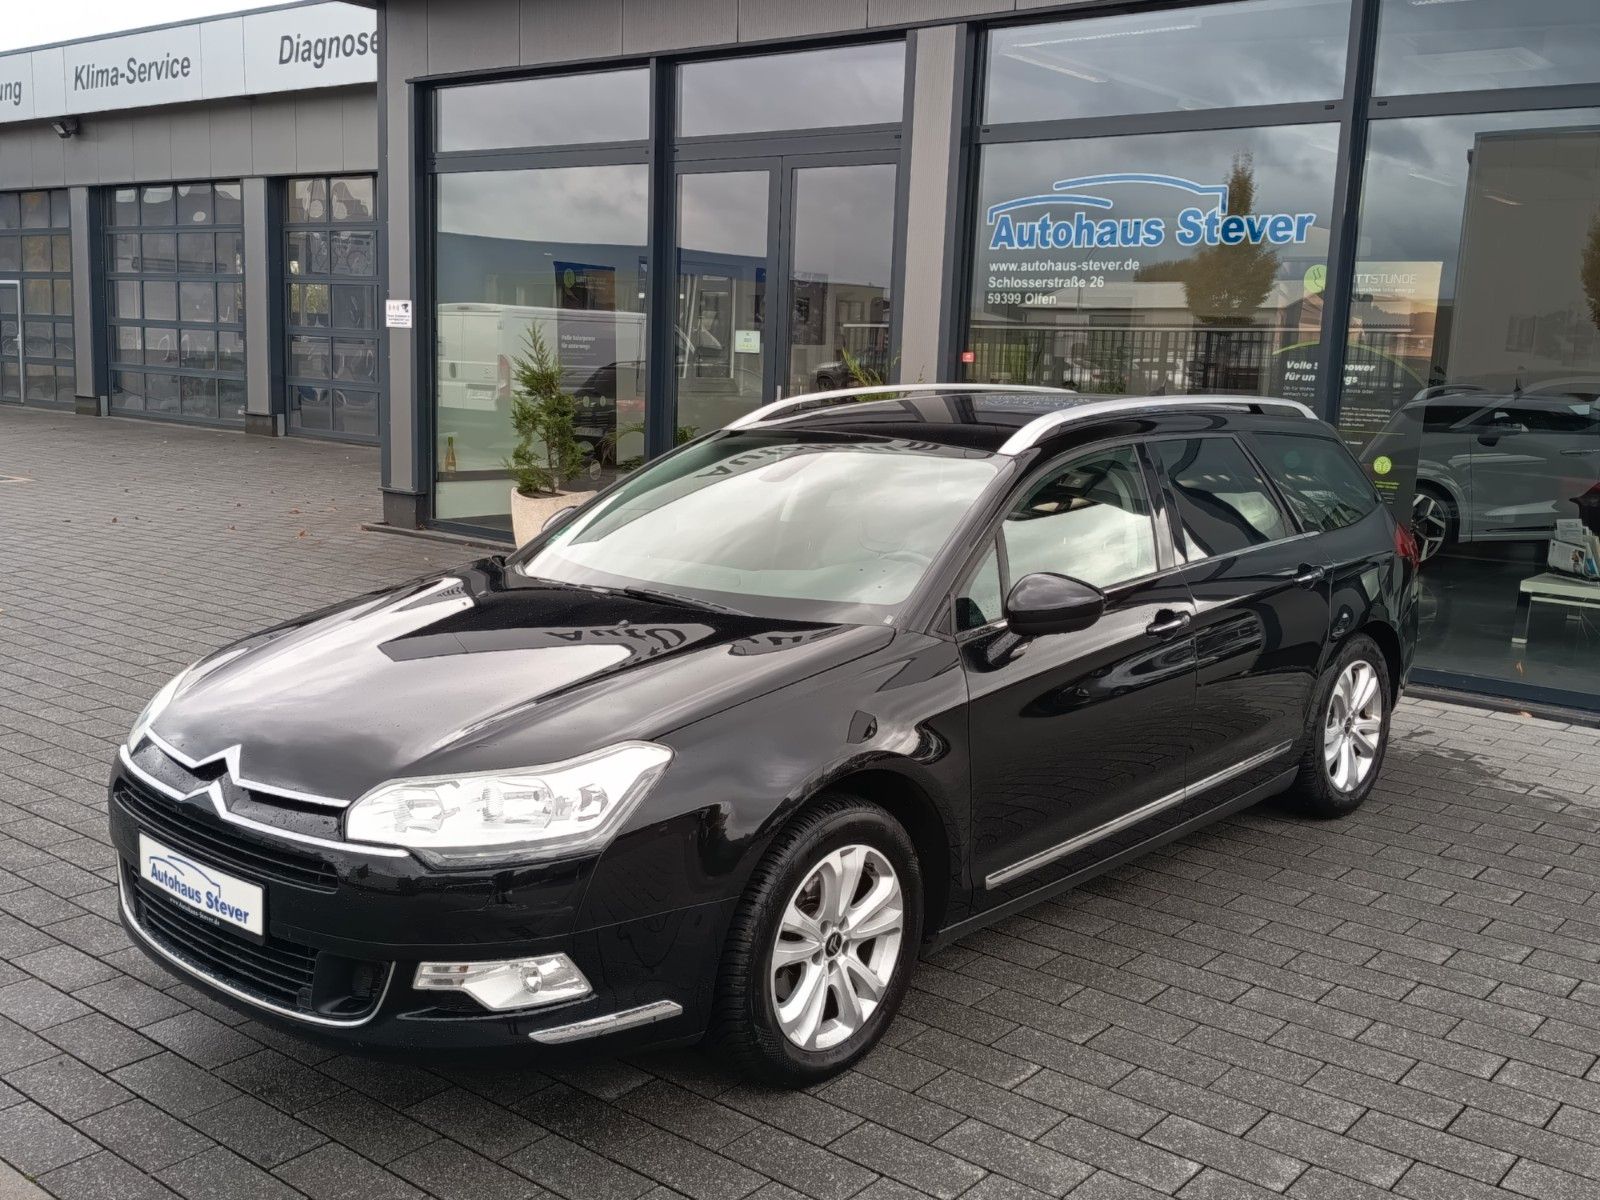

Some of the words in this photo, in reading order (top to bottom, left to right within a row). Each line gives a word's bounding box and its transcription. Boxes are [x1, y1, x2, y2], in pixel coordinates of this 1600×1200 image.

[279, 30, 377, 69] Diagnose
[74, 53, 191, 91] Klima-Service
[989, 211, 1166, 250] Autohaus
[1175, 207, 1316, 246] Stever
[989, 258, 1140, 272] www.autohaus-stever.de
[988, 276, 1086, 288] Schlosserstraße
[1089, 276, 1105, 288] 26
[987, 293, 1021, 305] 59399
[1025, 293, 1057, 305] Olfen
[1286, 361, 1312, 370] Volle
[1284, 372, 1300, 381] für
[151, 863, 202, 903] Autohaus
[205, 891, 249, 924] Stever
